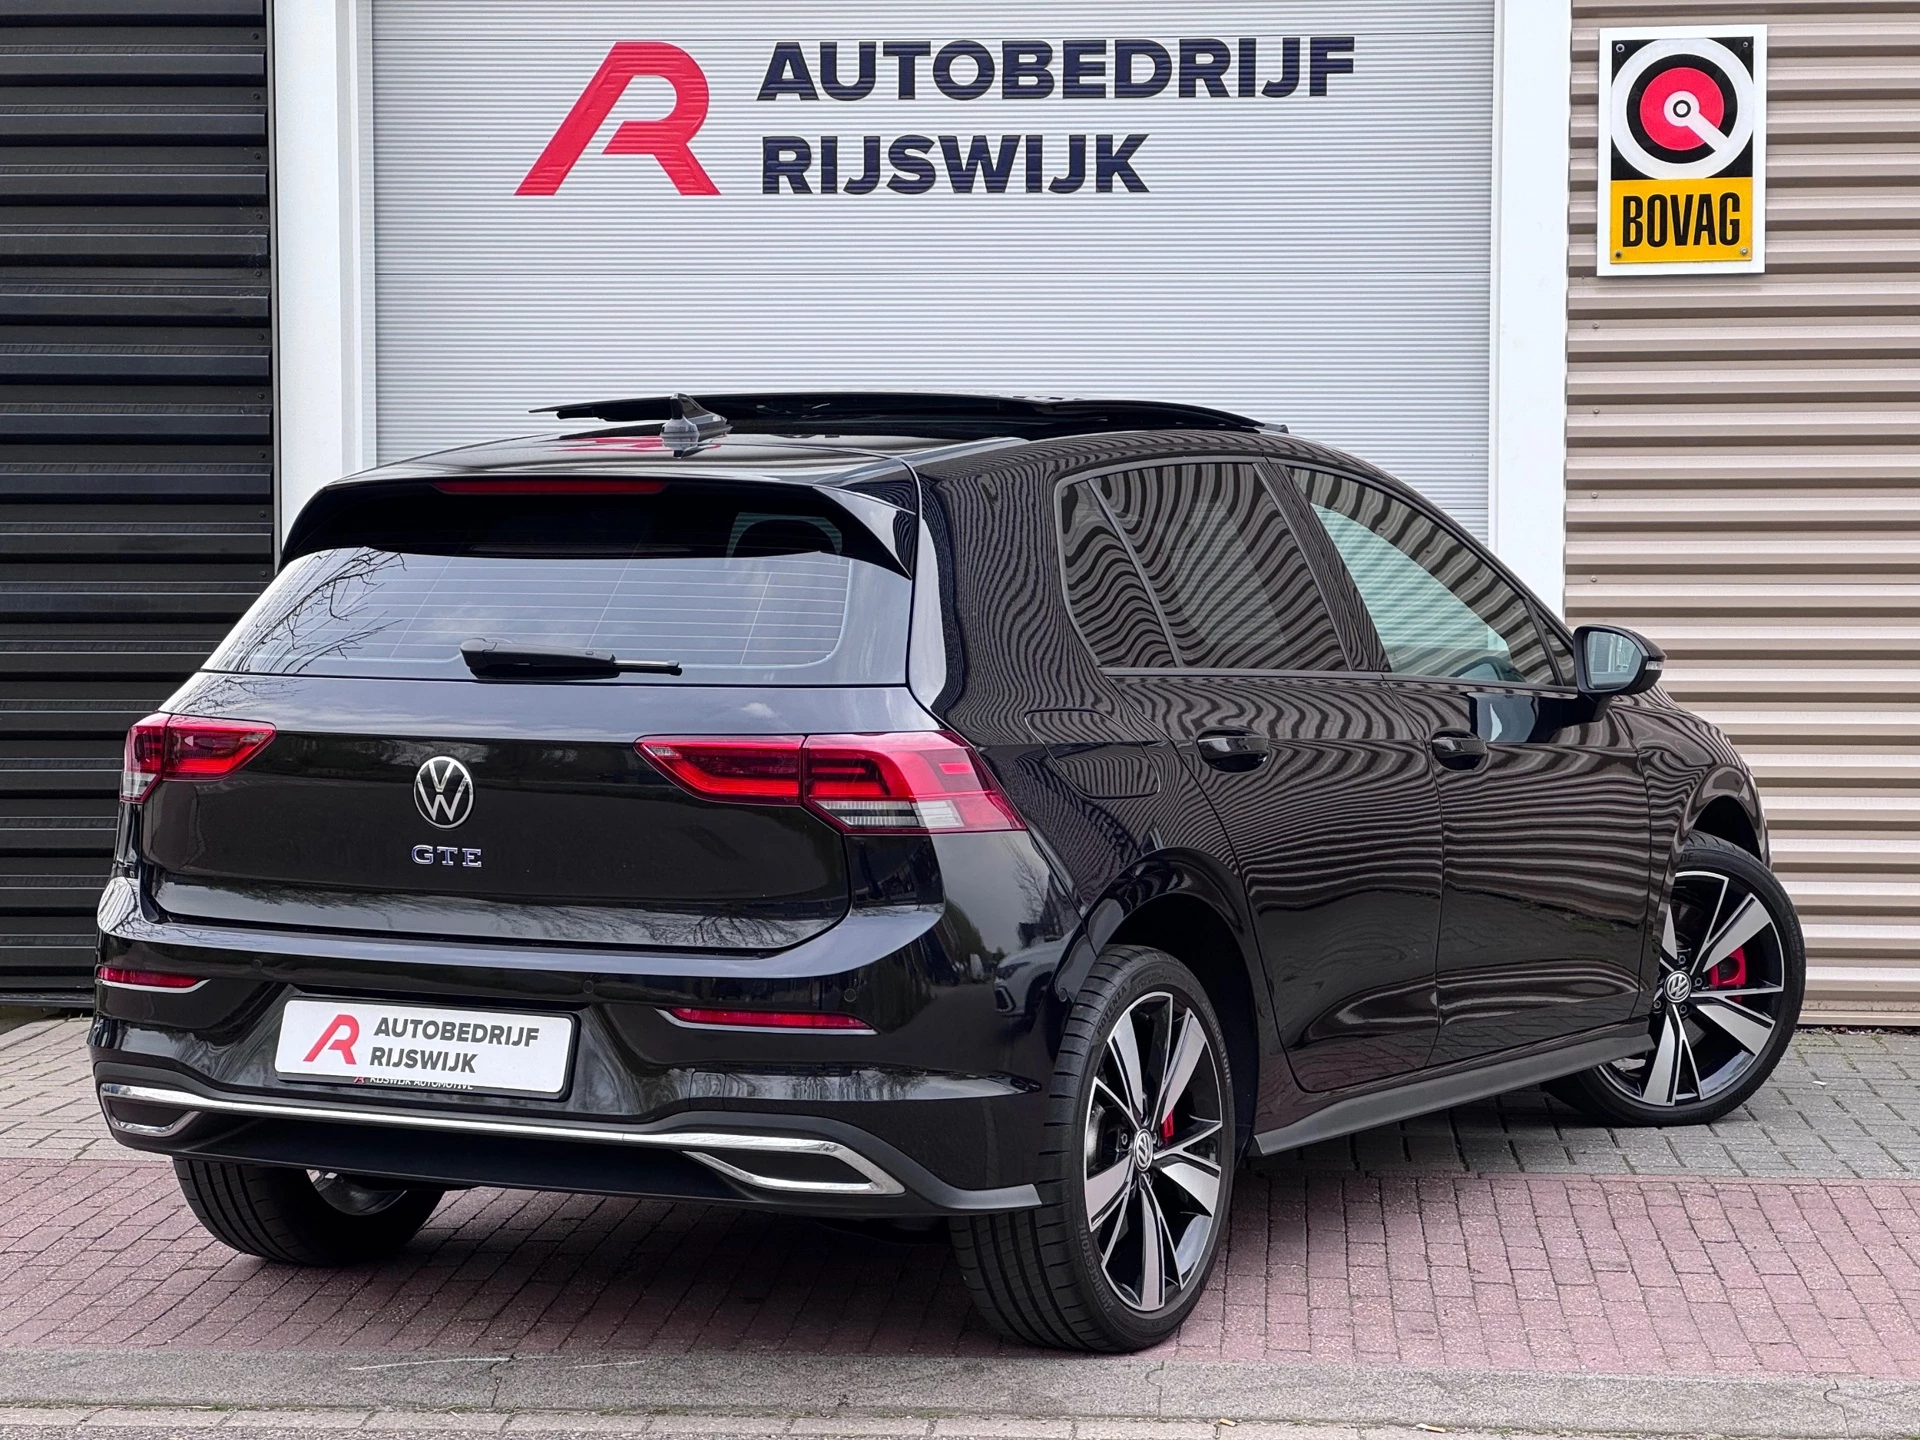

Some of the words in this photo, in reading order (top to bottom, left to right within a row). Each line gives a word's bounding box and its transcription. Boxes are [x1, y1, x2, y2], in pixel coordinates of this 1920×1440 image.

[757, 36, 1356, 101] AUTOBEDRIJF
[763, 133, 1150, 195] RIJSWIJK
[1622, 191, 1741, 248] BOVAG
[411, 844, 482, 868] GTE
[373, 1016, 540, 1047] AUTOBEDRIJF
[369, 1047, 479, 1074] RIJSWIJK
